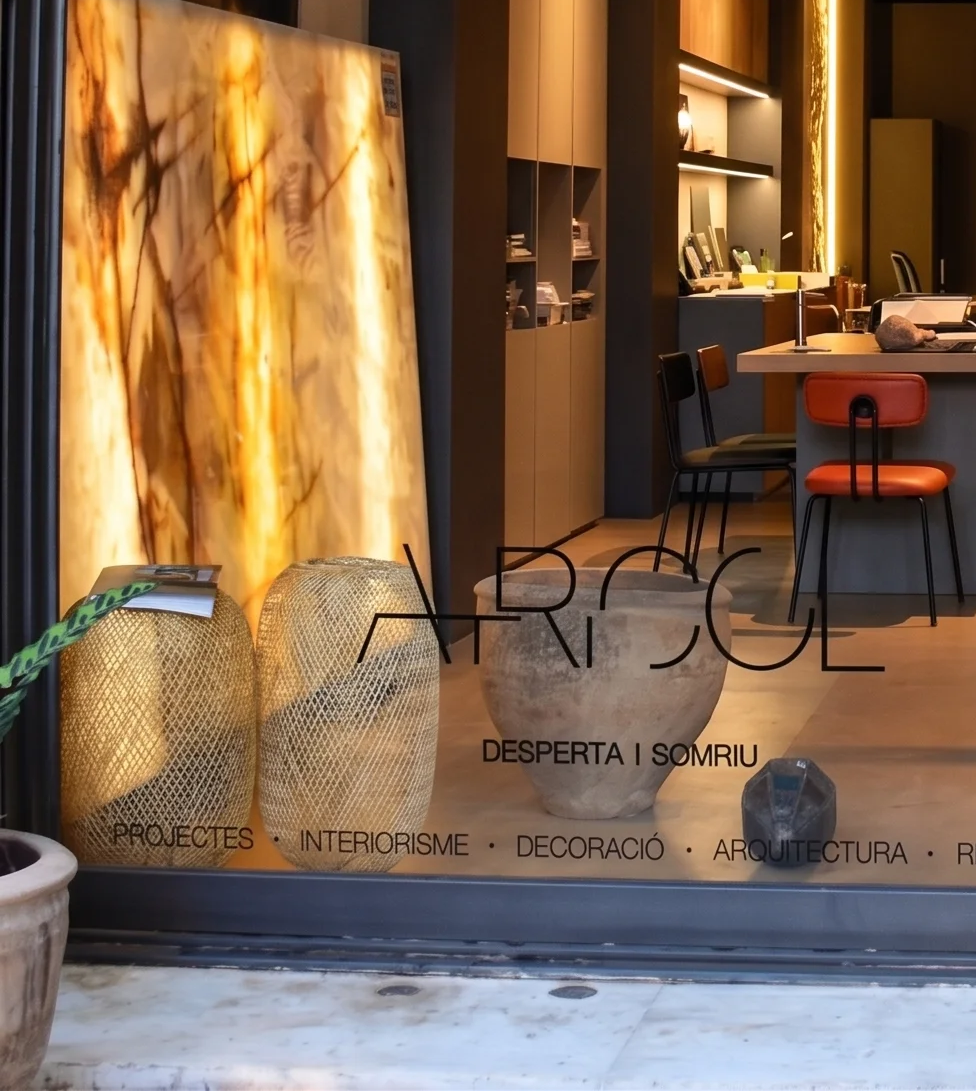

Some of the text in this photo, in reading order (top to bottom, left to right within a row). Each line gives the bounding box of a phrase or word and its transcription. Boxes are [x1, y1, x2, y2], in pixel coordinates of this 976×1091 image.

[482, 739, 758, 767] DESPERTA I SOMRIU
[113, 823, 254, 849] PROJECTES
[300, 829, 469, 856] INTERIORISME
[517, 833, 665, 860] DECORACIÓ
[713, 838, 908, 865] ARQUITECTURA
